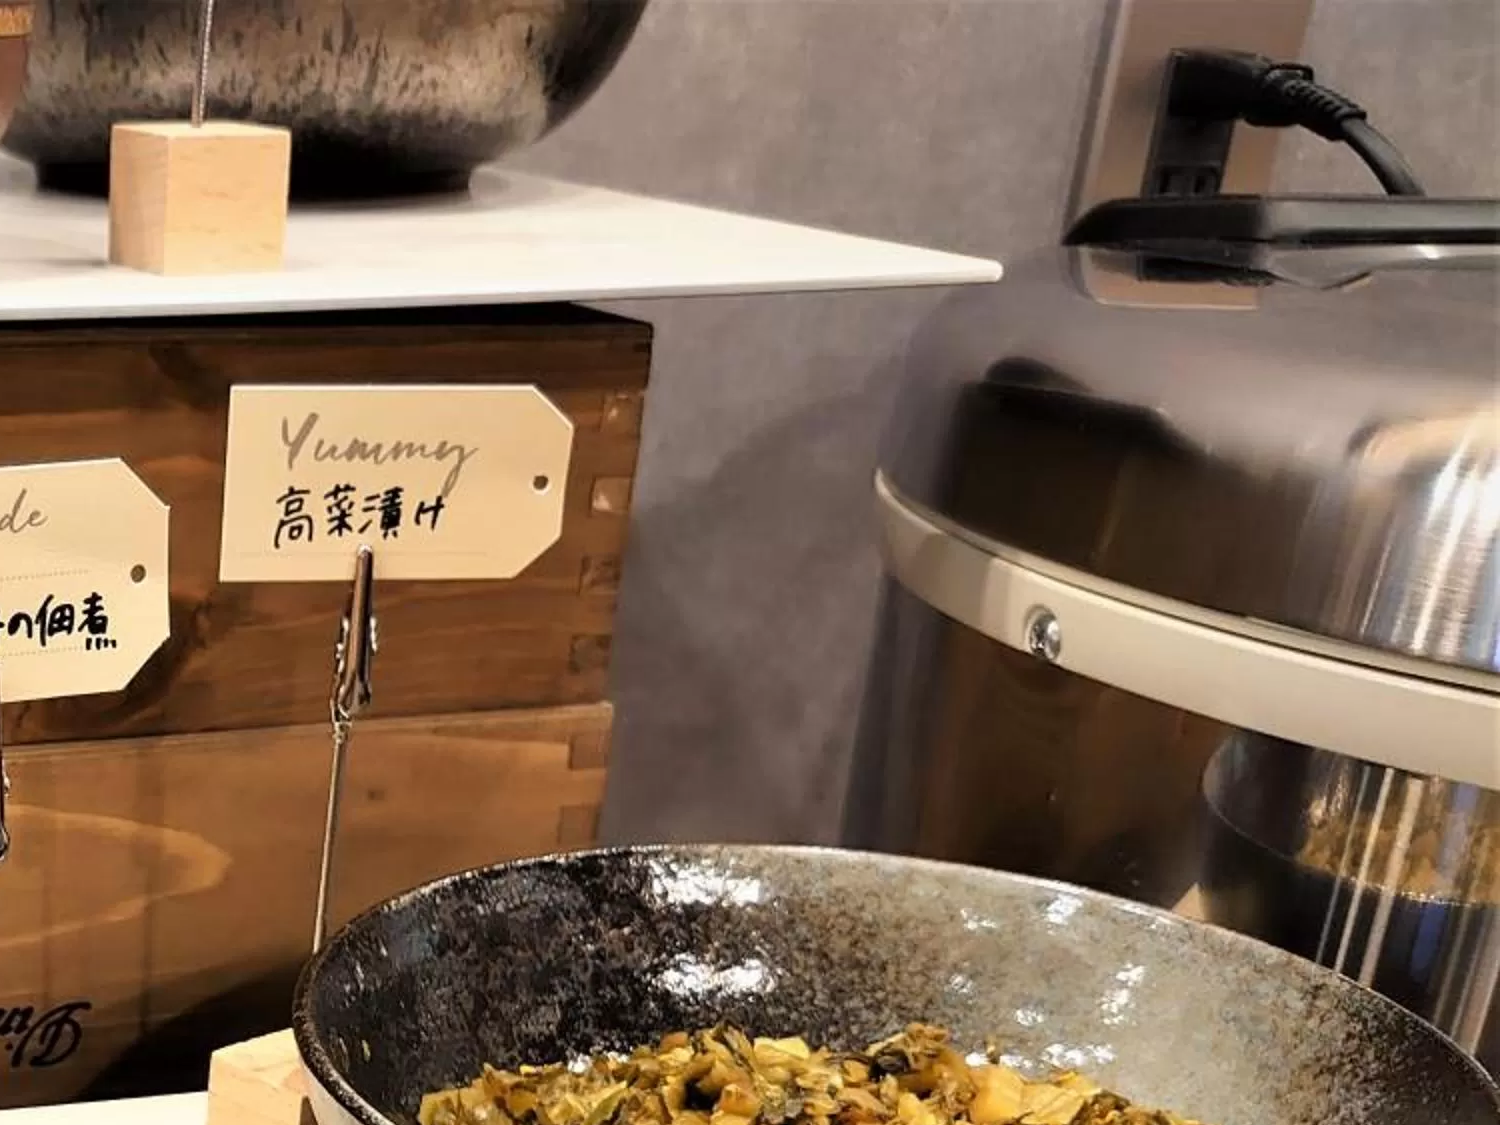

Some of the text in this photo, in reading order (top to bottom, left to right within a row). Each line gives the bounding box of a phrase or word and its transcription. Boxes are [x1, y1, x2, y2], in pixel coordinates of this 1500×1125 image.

[281, 412, 479, 498] Yummy
[274, 484, 444, 549] 高菜漬け
